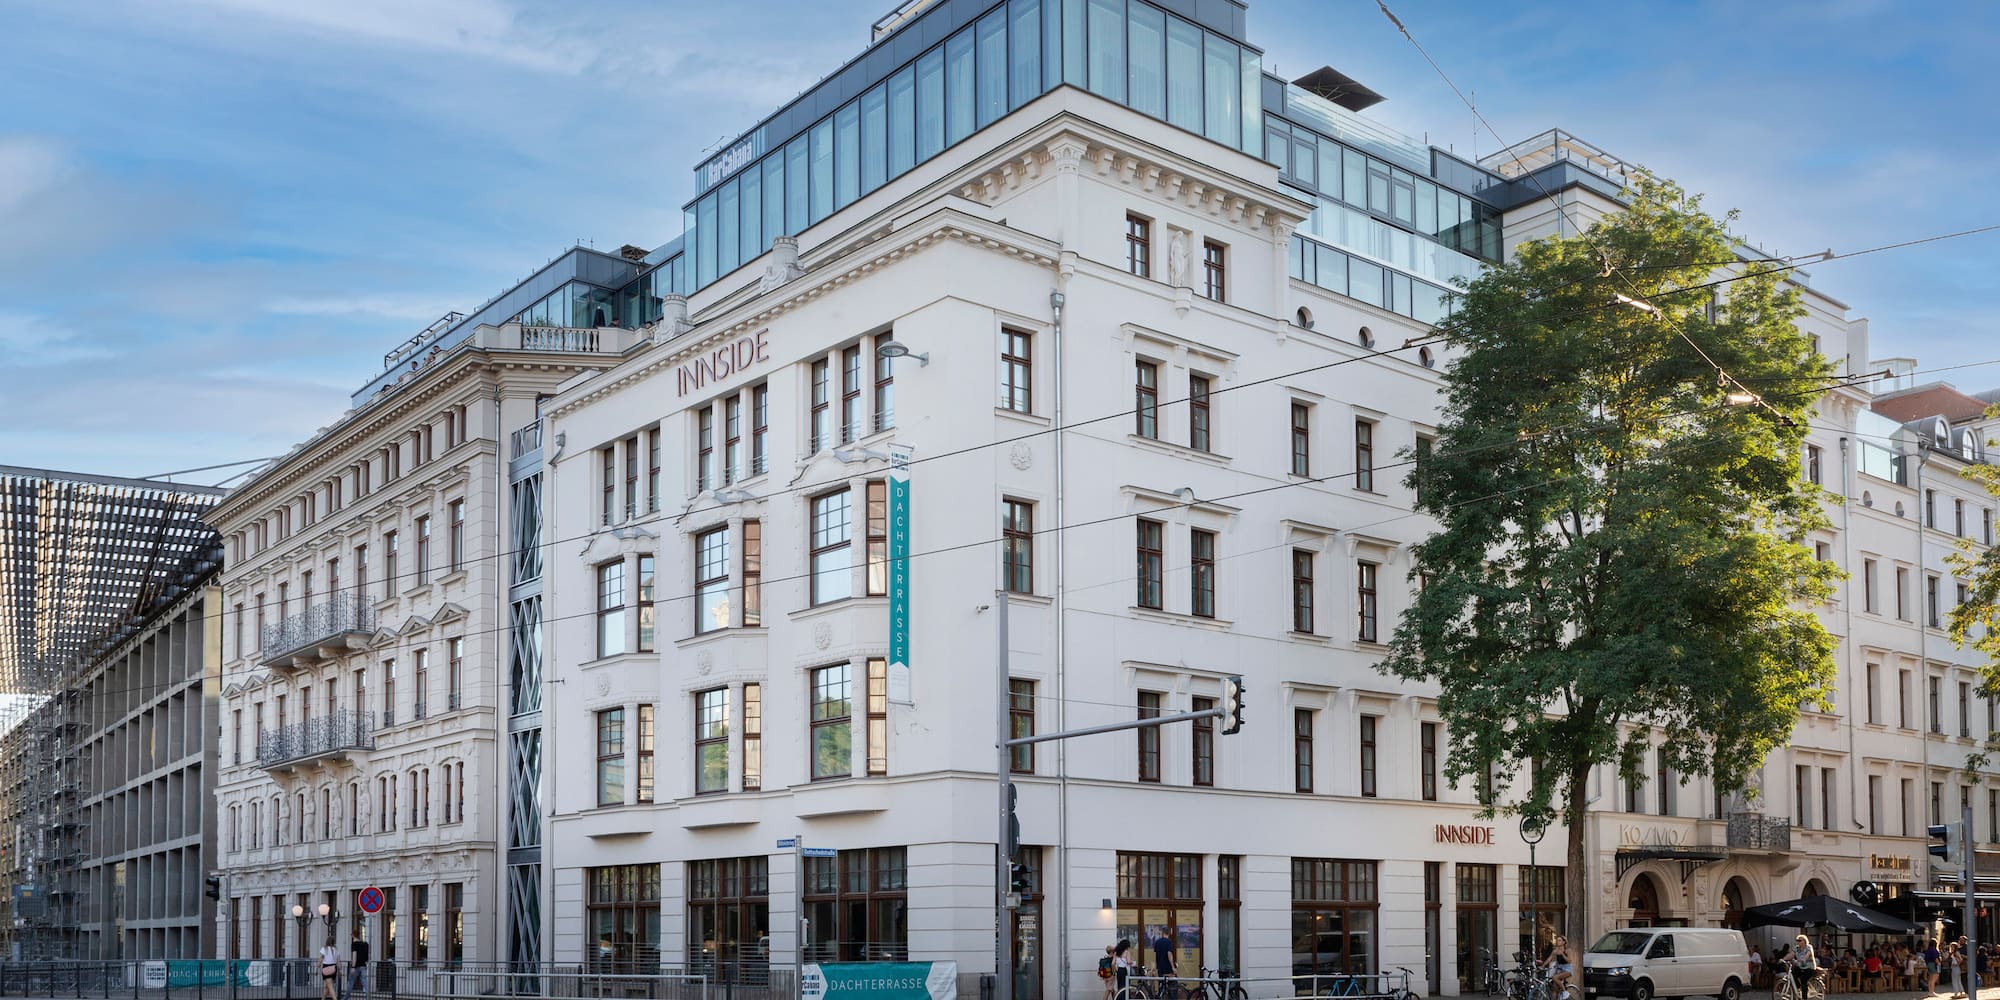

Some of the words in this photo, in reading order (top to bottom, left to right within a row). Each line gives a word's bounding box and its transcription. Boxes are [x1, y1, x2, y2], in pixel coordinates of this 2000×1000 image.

[708, 140, 752, 188] BarCabana
[677, 328, 770, 398] INNSIDE
[896, 486, 904, 657] DACHTERRASSE
[1435, 824, 1496, 845] INNSIDE
[173, 969, 244, 978] DACHERRAE
[831, 977, 923, 991] DACHTERRASSE
